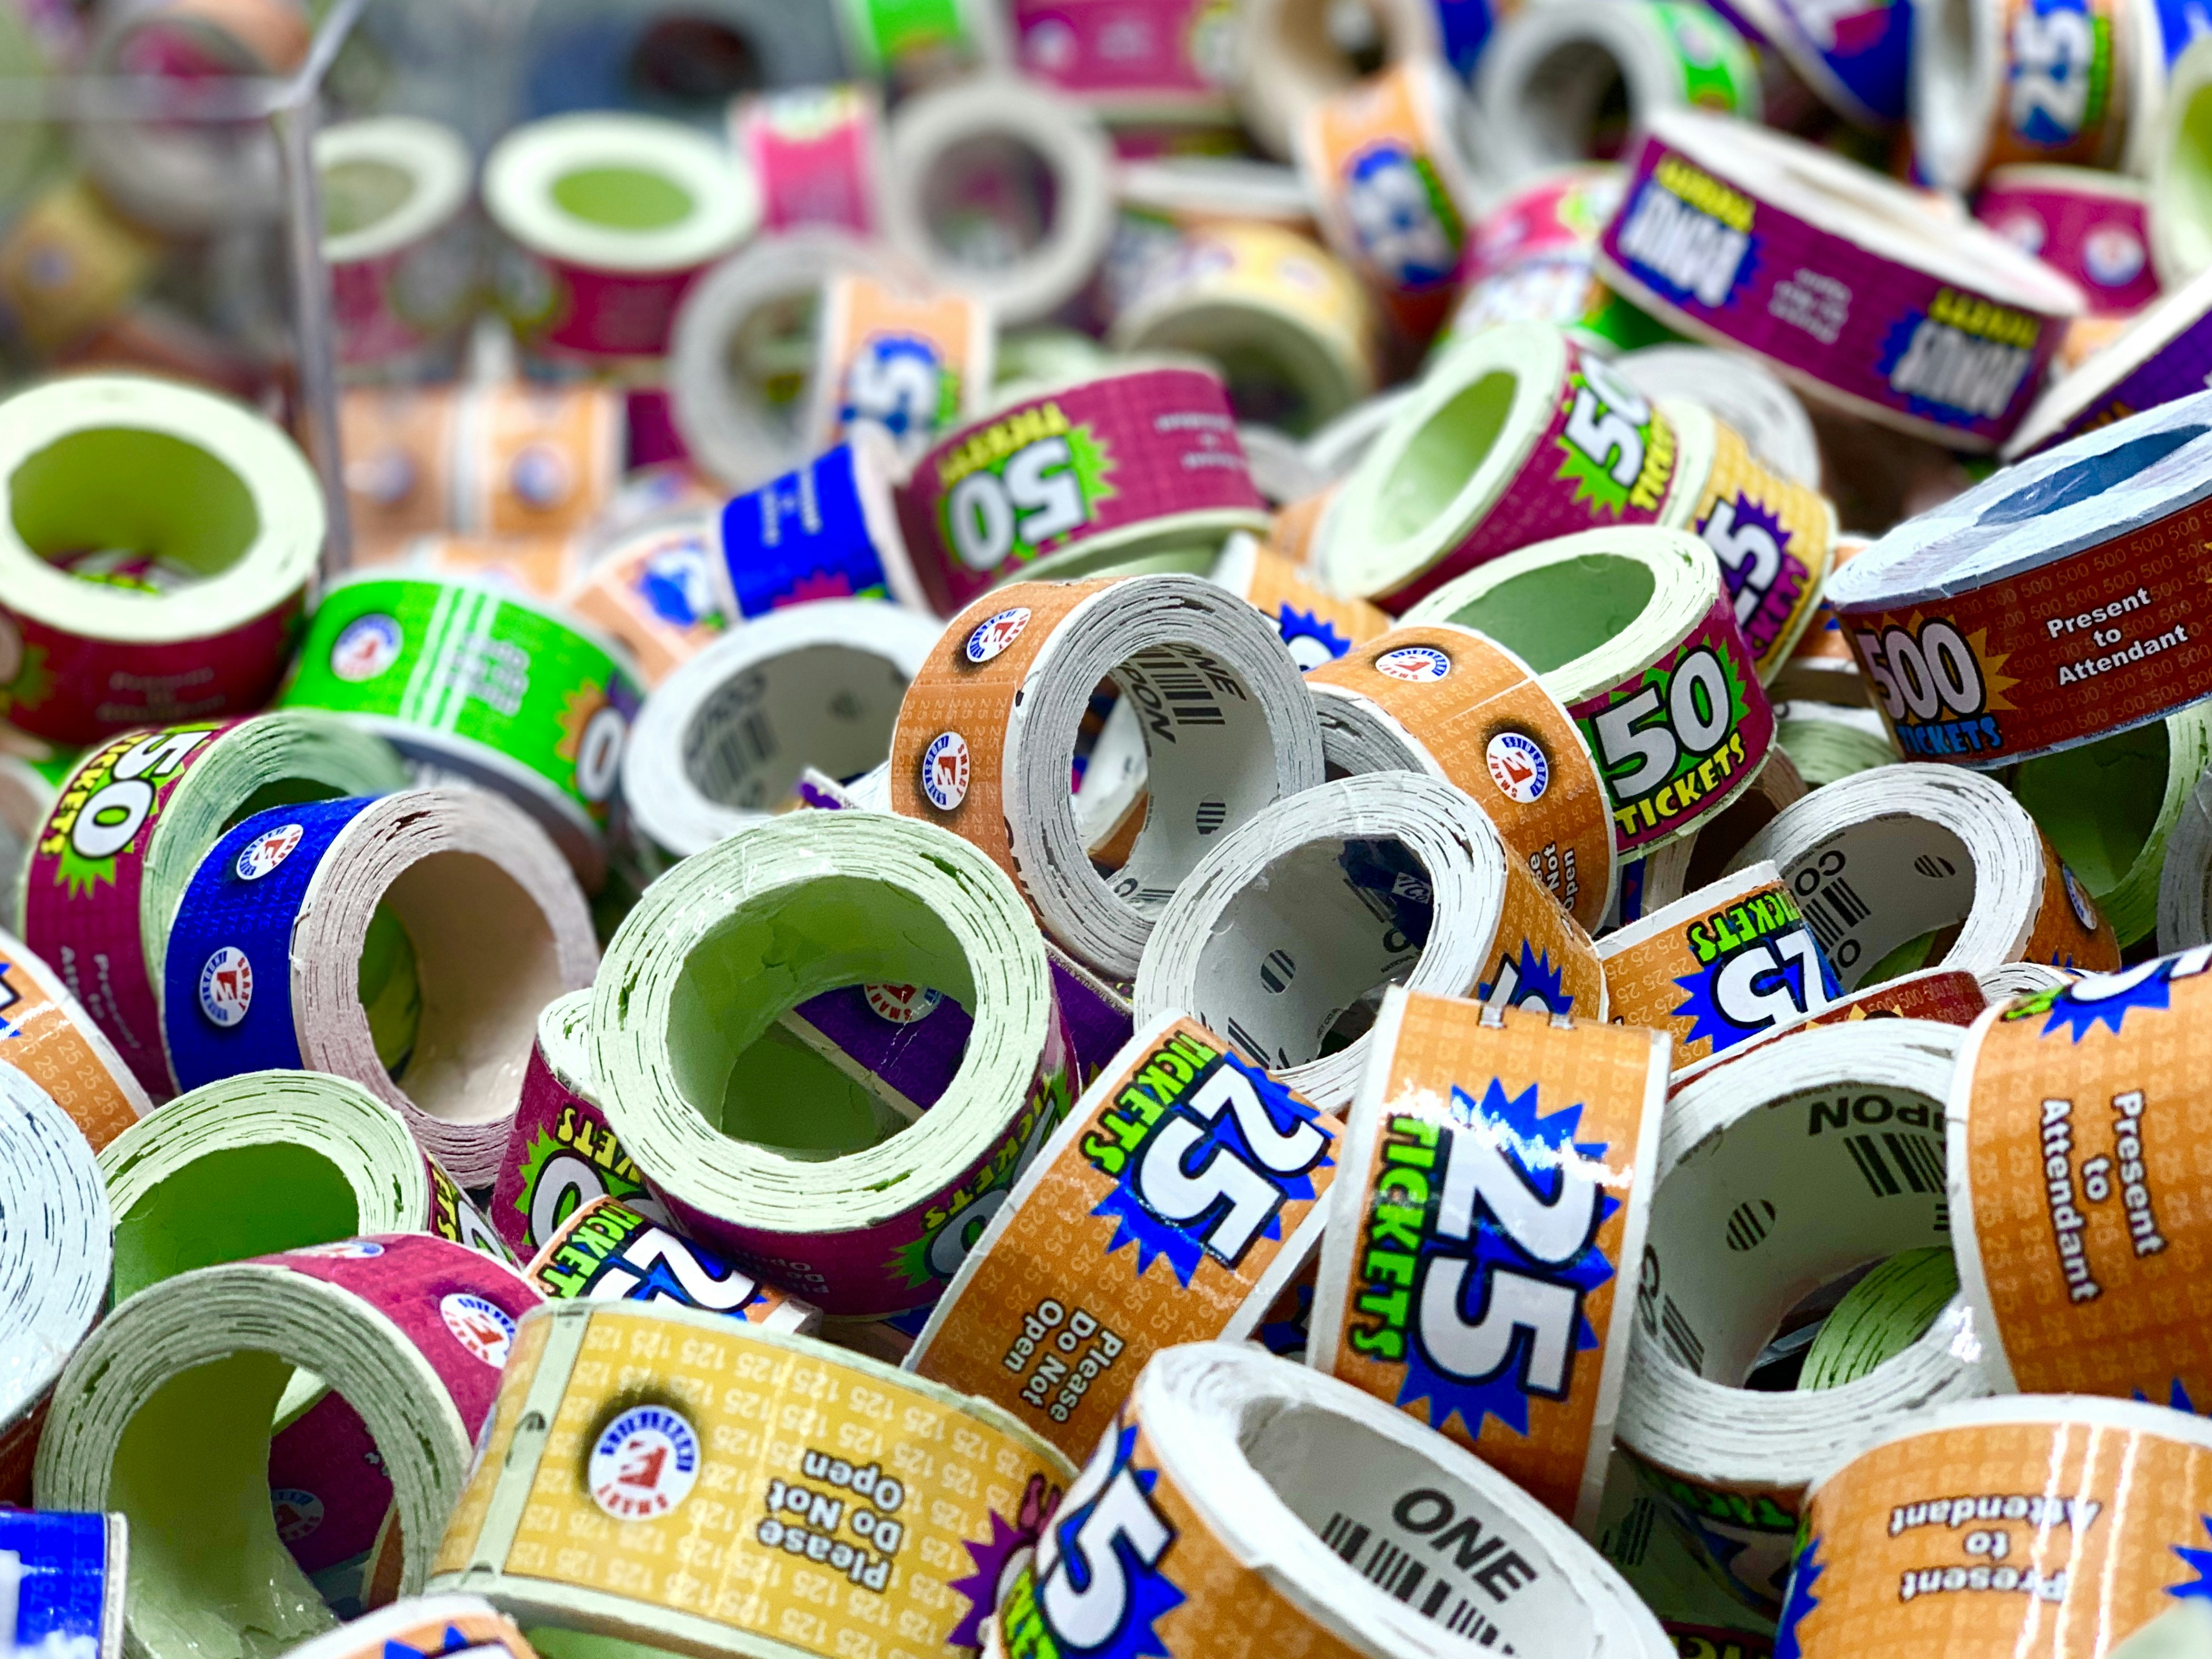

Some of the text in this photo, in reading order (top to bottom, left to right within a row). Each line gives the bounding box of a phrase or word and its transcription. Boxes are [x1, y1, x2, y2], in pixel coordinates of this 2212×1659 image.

[950, 437, 1086, 568] 50
[2047, 587, 2151, 638] Present
[2059, 624, 2189, 686] Attendant
[2093, 628, 2122, 647] to
[1856, 622, 1981, 719] 500
[1595, 650, 1730, 799] 50
[40, 733, 151, 854] TICKETS
[73, 731, 212, 857] 50
[1489, 753, 1518, 798] SMART
[1613, 732, 1745, 835] TICKETS
[1690, 890, 1801, 962] TICKETS
[1082, 1031, 1219, 1173] TICKETS
[1140, 1063, 1325, 1266] 25
[2043, 1099, 2102, 1302] Attendant
[2083, 1155, 2112, 1202] to
[2114, 1090, 2166, 1256] Present
[1353, 1117, 1443, 1358] TICKETS
[1420, 1131, 1603, 1393] 25
[1004, 1300, 1064, 1371] Open
[1022, 1311, 1098, 1405] Do Not
[1050, 1330, 1124, 1421] Please
[768, 1480, 902, 1552] Do Not
[804, 1451, 903, 1510] Open
[1890, 1496, 2100, 1535] Attendant
[759, 1519, 891, 1591] Please
[1392, 1488, 1538, 1603] ONE
[1901, 1567, 2070, 1602] Present
[1965, 1531, 2010, 1559] to
